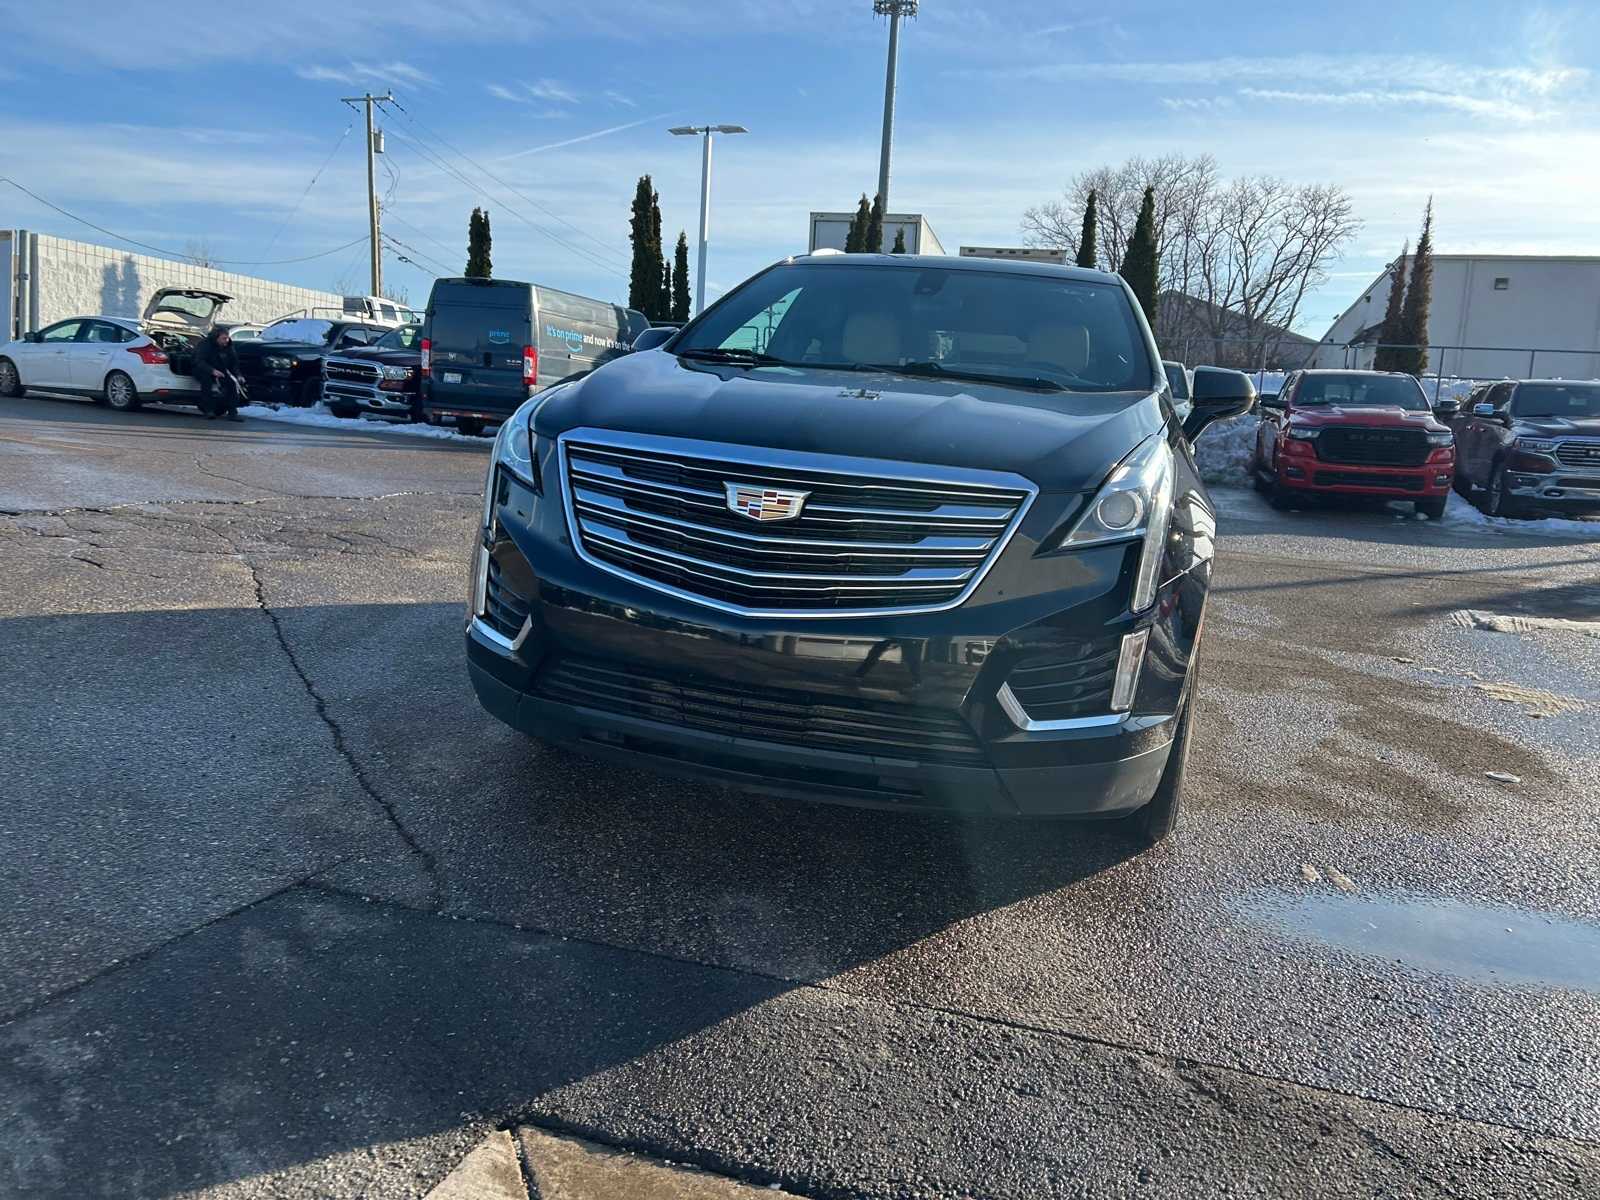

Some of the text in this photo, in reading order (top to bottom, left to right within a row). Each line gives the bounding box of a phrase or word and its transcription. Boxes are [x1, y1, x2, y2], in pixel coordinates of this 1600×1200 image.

[546, 325, 556, 337] It's
[556, 329, 564, 338] on
[565, 330, 583, 342] prime
[583, 334, 594, 344] and
[594, 337, 605, 346] now
[606, 337, 614, 348] it's
[622, 341, 630, 351] the
